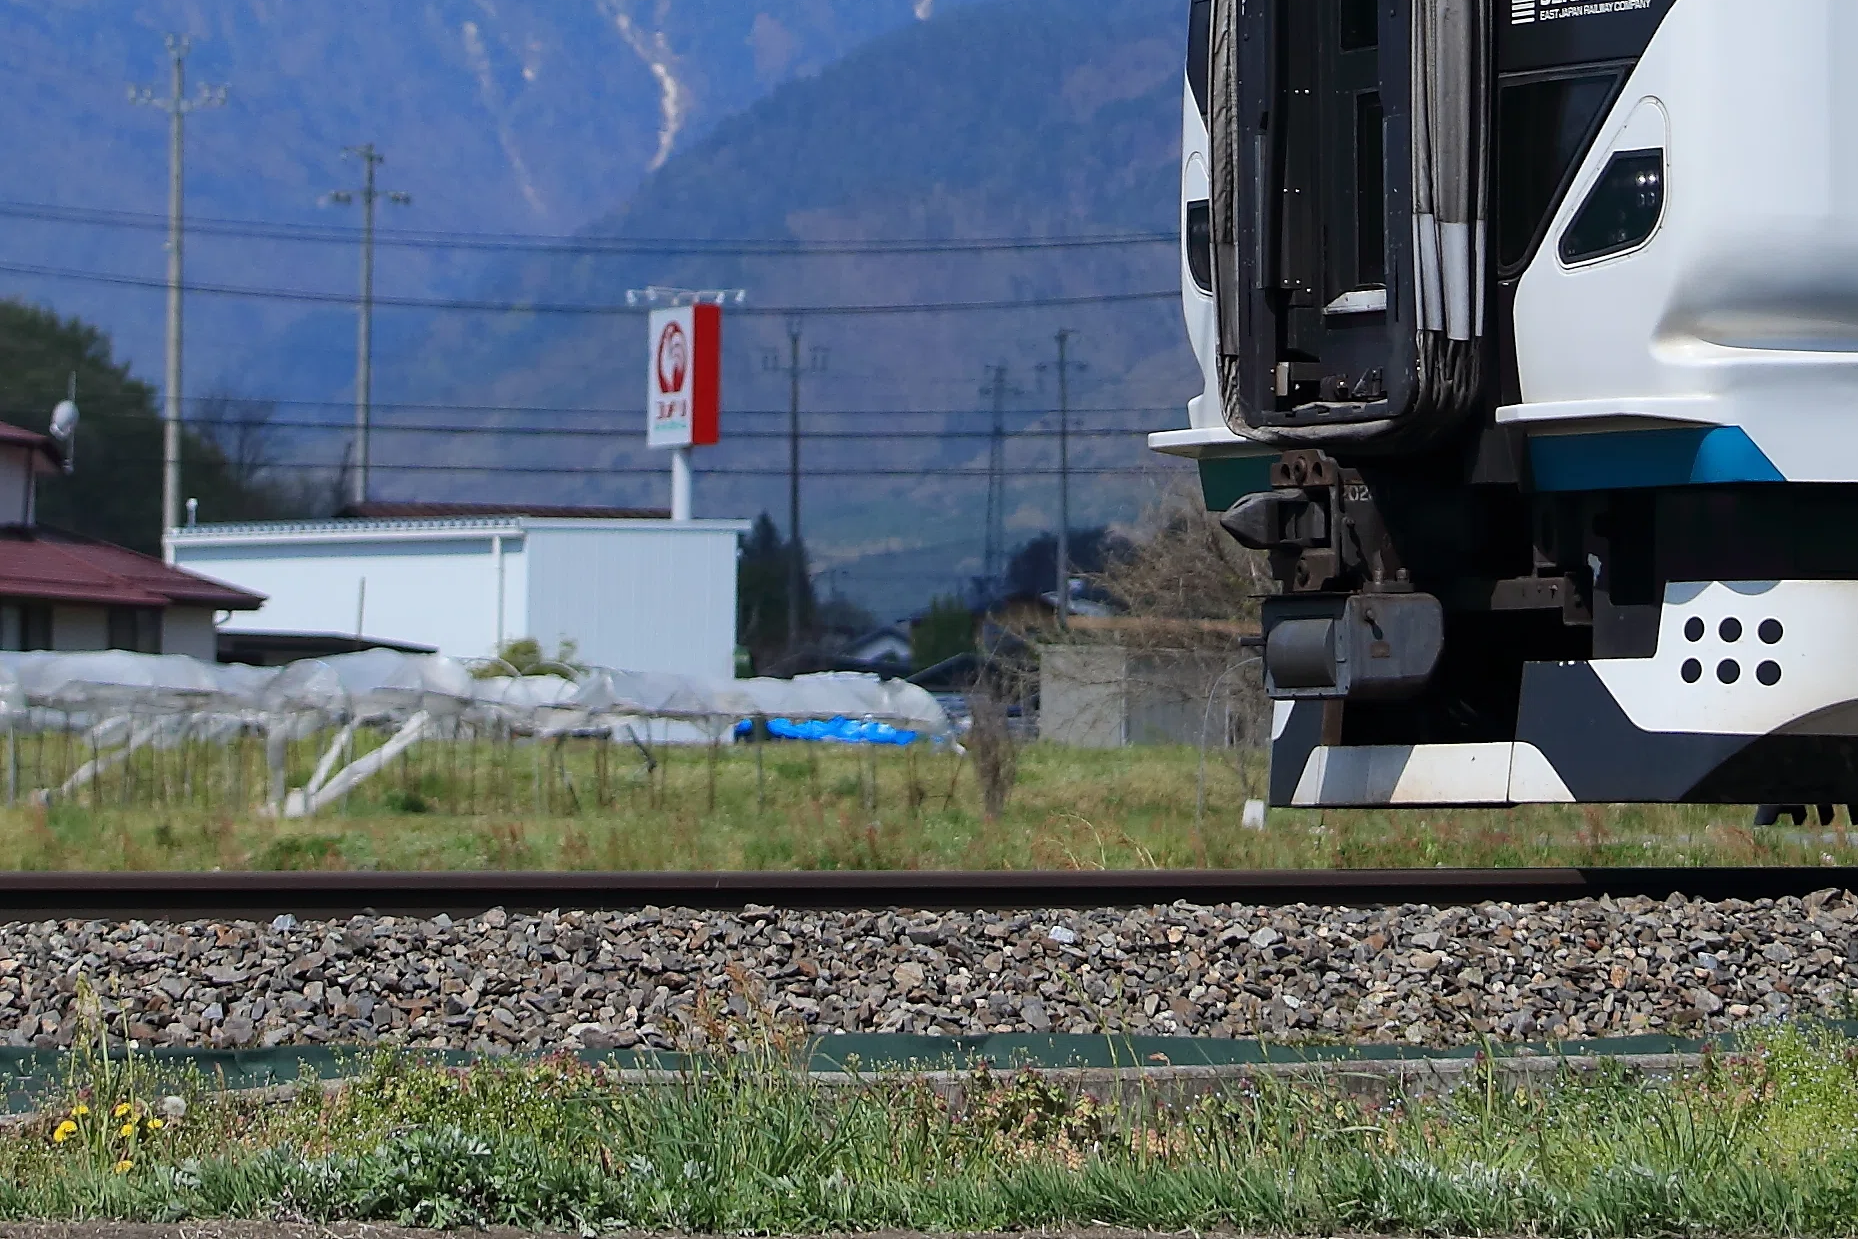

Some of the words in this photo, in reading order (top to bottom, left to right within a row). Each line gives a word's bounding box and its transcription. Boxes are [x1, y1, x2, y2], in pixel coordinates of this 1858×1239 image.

[1539, 9, 1559, 21] EAST
[1559, 5, 1583, 18] JAPAN
[1583, 1, 1614, 15] RAILWAY
